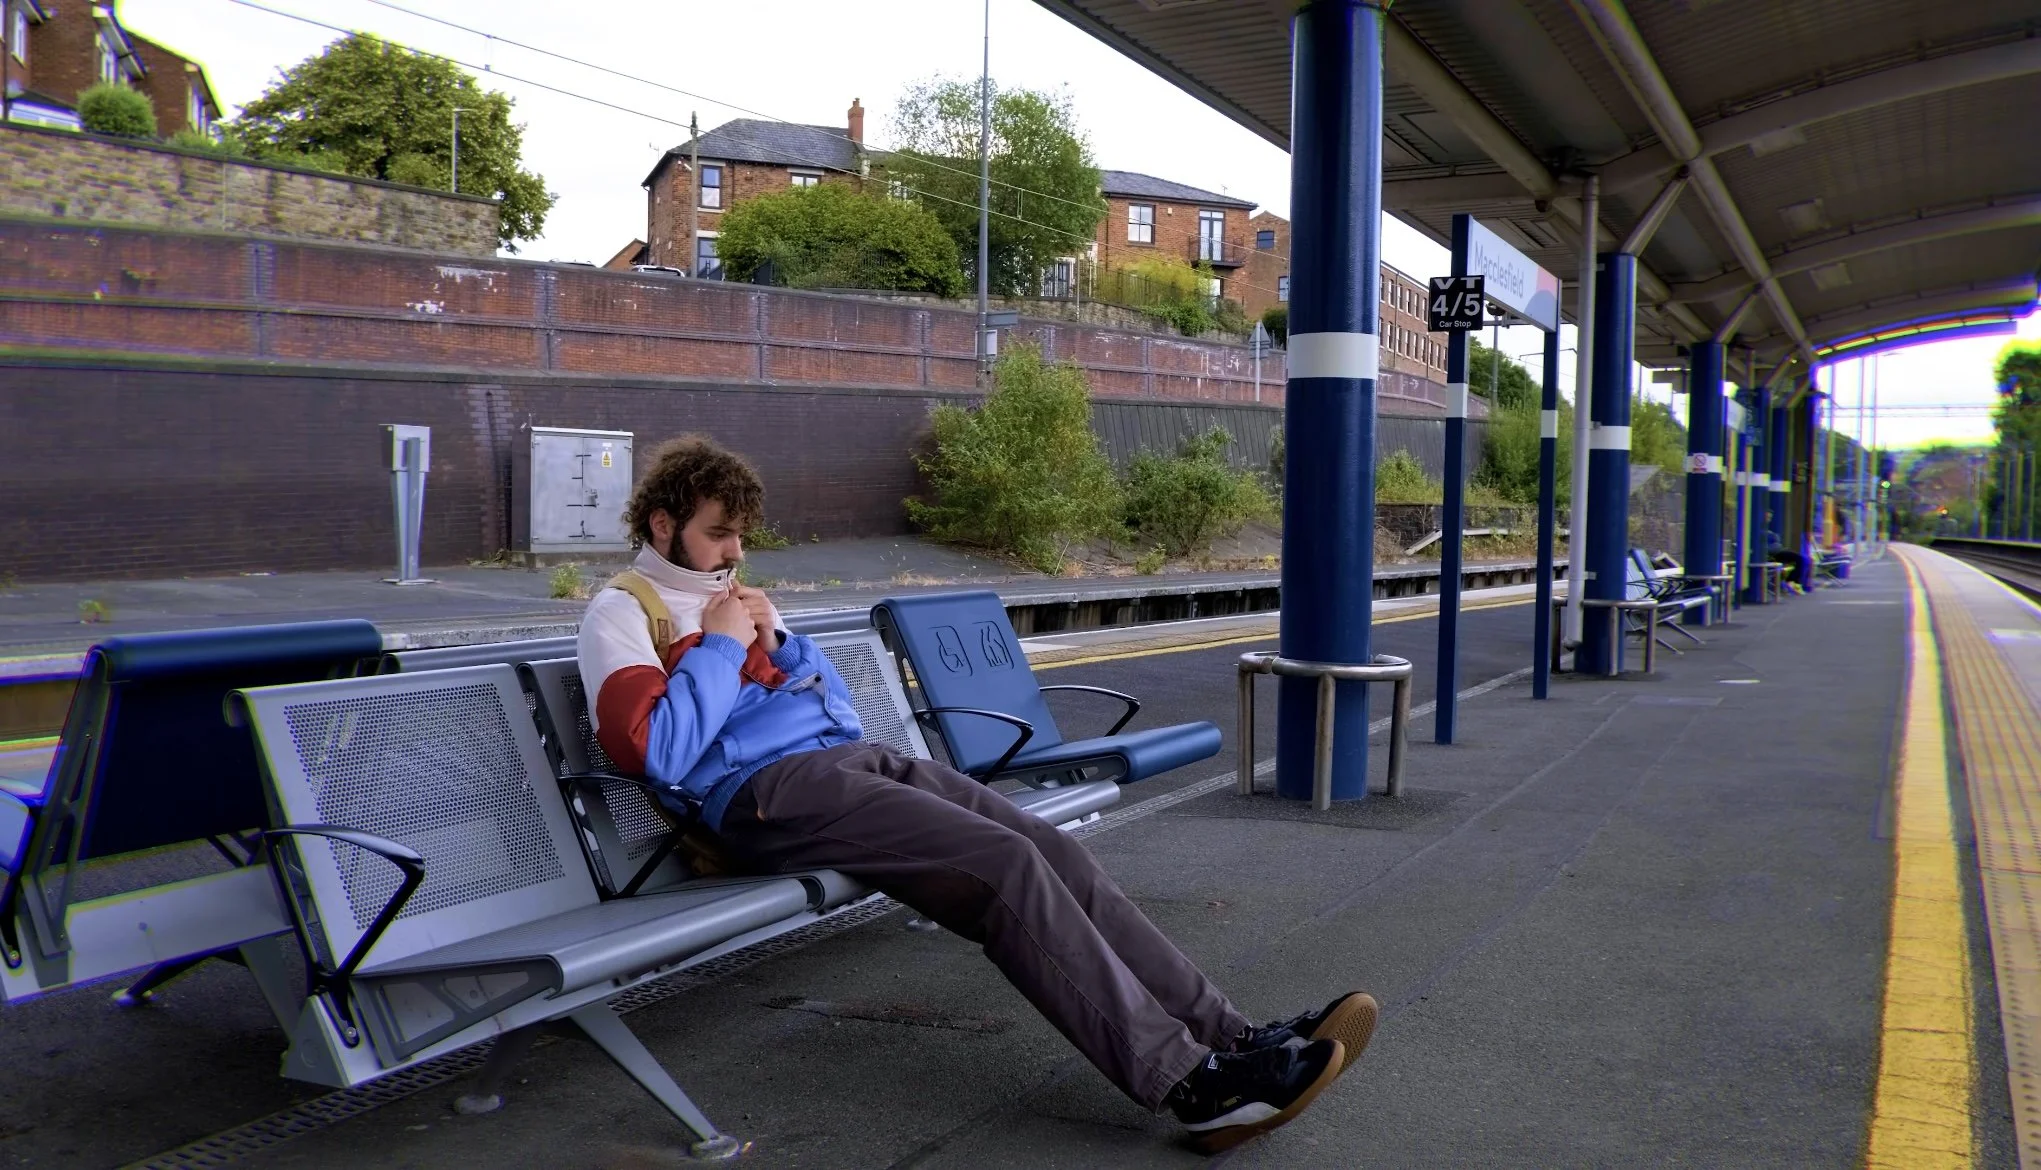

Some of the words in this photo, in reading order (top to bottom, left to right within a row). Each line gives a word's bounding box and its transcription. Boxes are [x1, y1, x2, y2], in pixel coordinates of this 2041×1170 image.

[1474, 241, 1524, 298] Macclesfield
[1431, 292, 1480, 317] 4/5
[1454, 320, 1472, 328] Stop
